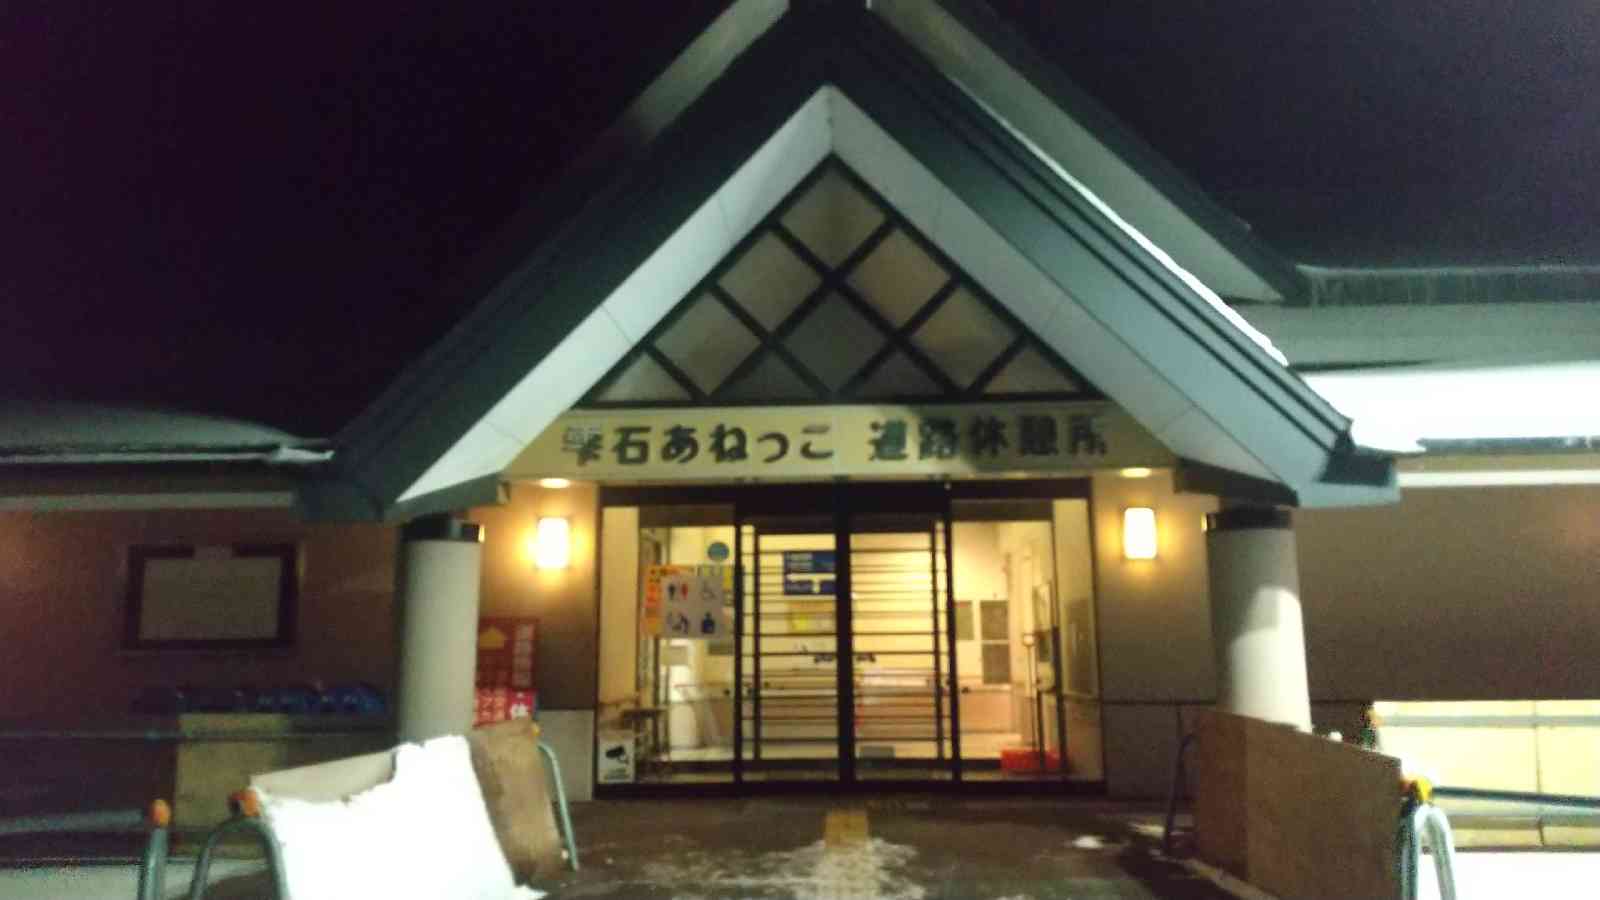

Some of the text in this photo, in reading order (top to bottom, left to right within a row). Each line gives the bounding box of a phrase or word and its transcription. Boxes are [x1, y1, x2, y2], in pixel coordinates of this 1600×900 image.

[561, 423, 835, 467] 雫石あねっこ
